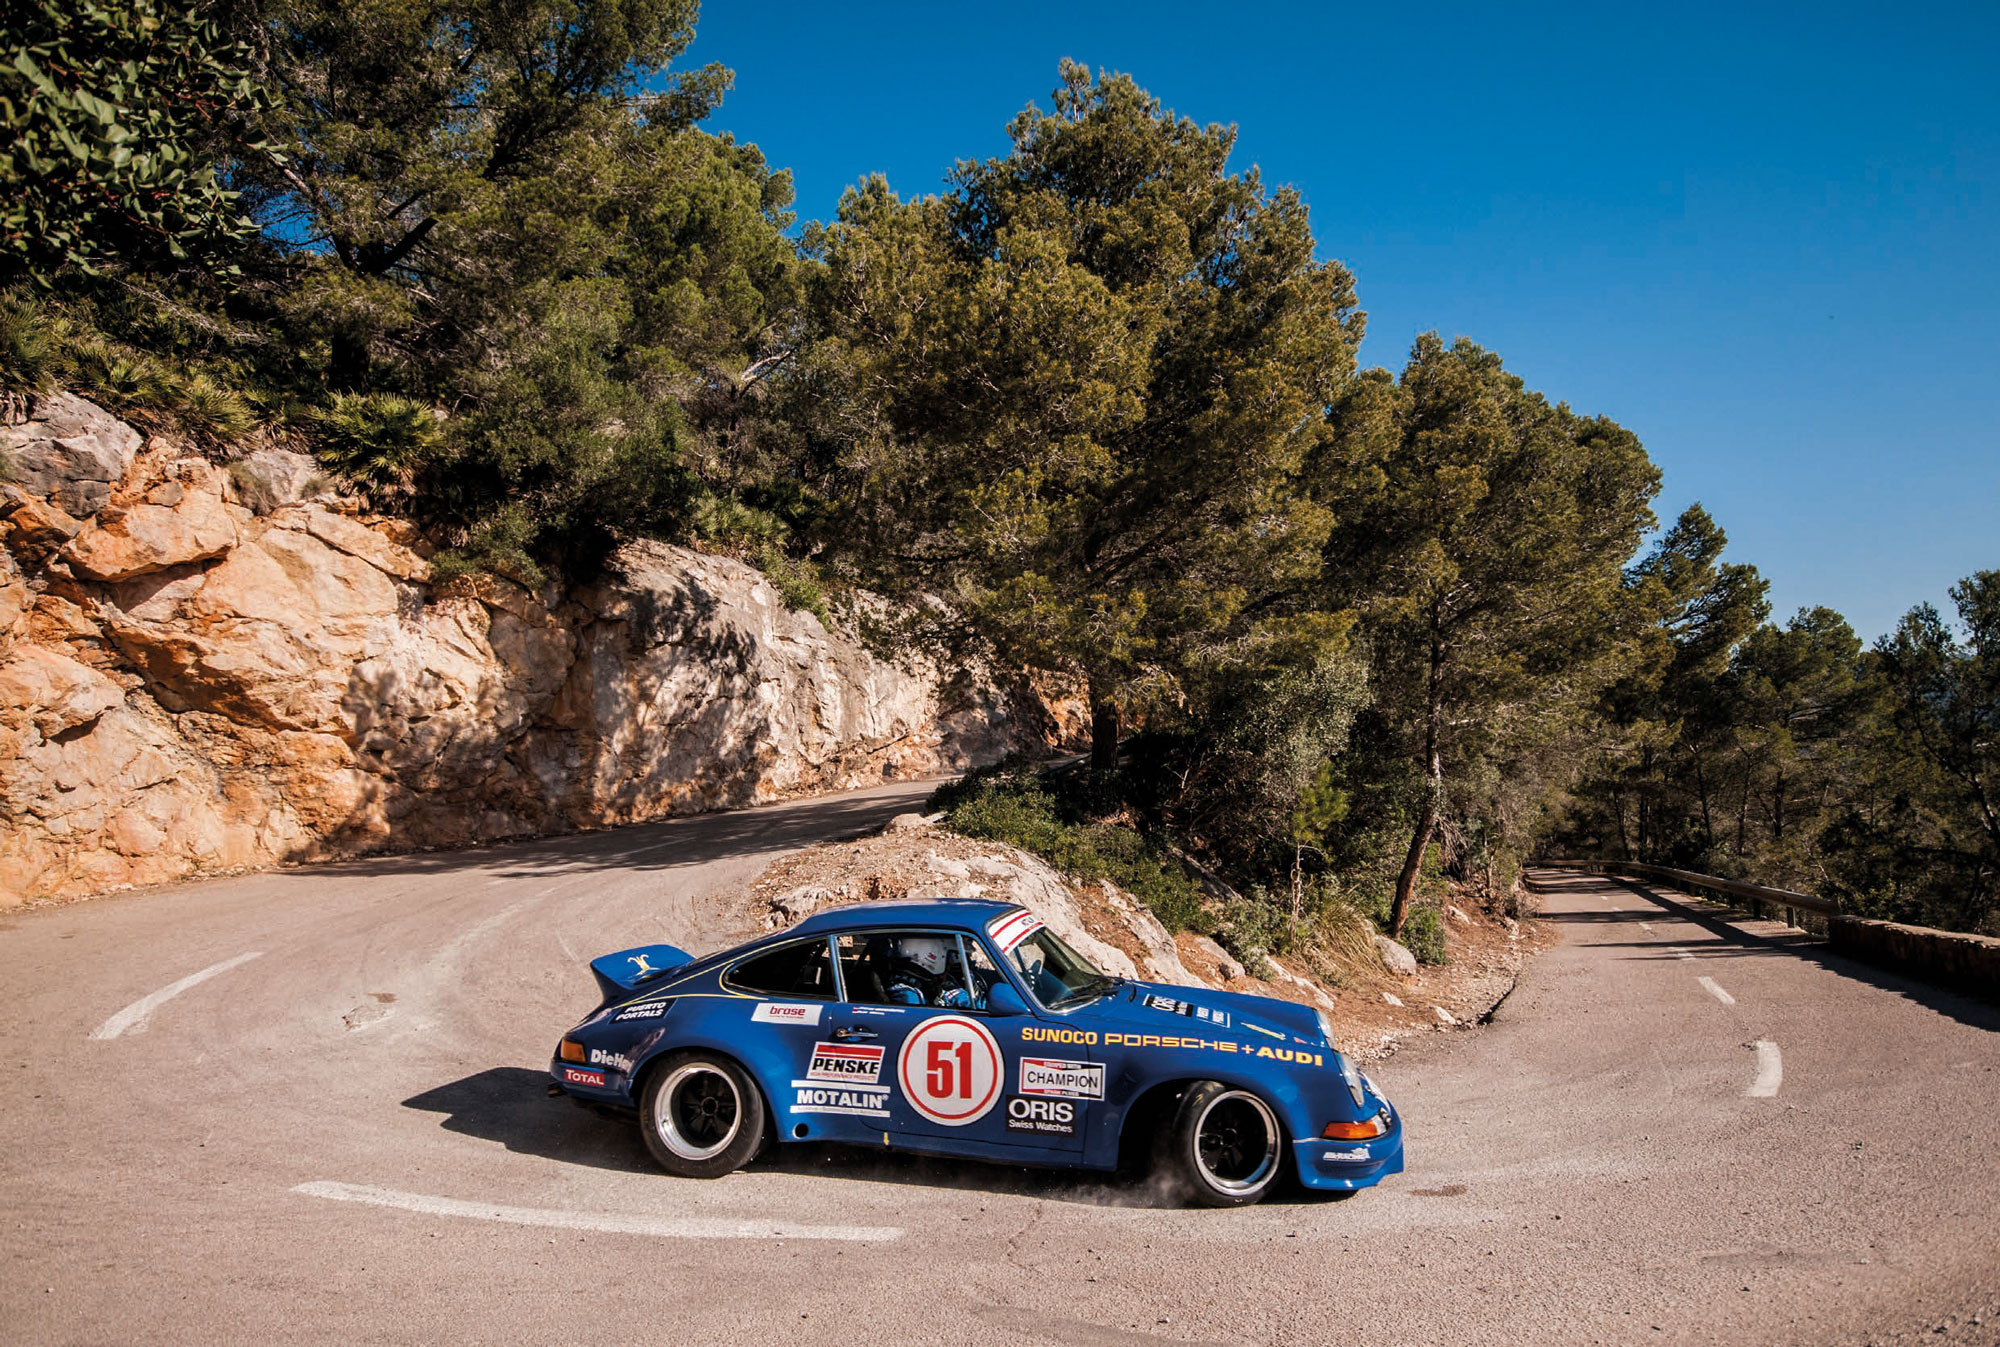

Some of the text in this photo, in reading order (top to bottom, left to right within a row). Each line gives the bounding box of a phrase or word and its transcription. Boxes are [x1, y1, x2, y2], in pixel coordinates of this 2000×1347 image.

[616, 1009, 664, 1020] PORTALS
[625, 1002, 667, 1013] PUERTO
[769, 1005, 806, 1016] brose
[1021, 1027, 1098, 1045] SUNOCO
[1104, 1033, 1238, 1053] PORSCHE
[1256, 1047, 1323, 1066] AUDI
[812, 1058, 879, 1074] PENSKE
[927, 1041, 972, 1098] 51
[566, 1069, 605, 1085] TOTAL
[1027, 1071, 1098, 1088] CHAMPION
[1009, 1099, 1073, 1122] ORIS
[1009, 1119, 1073, 1133] Swiss Watches
